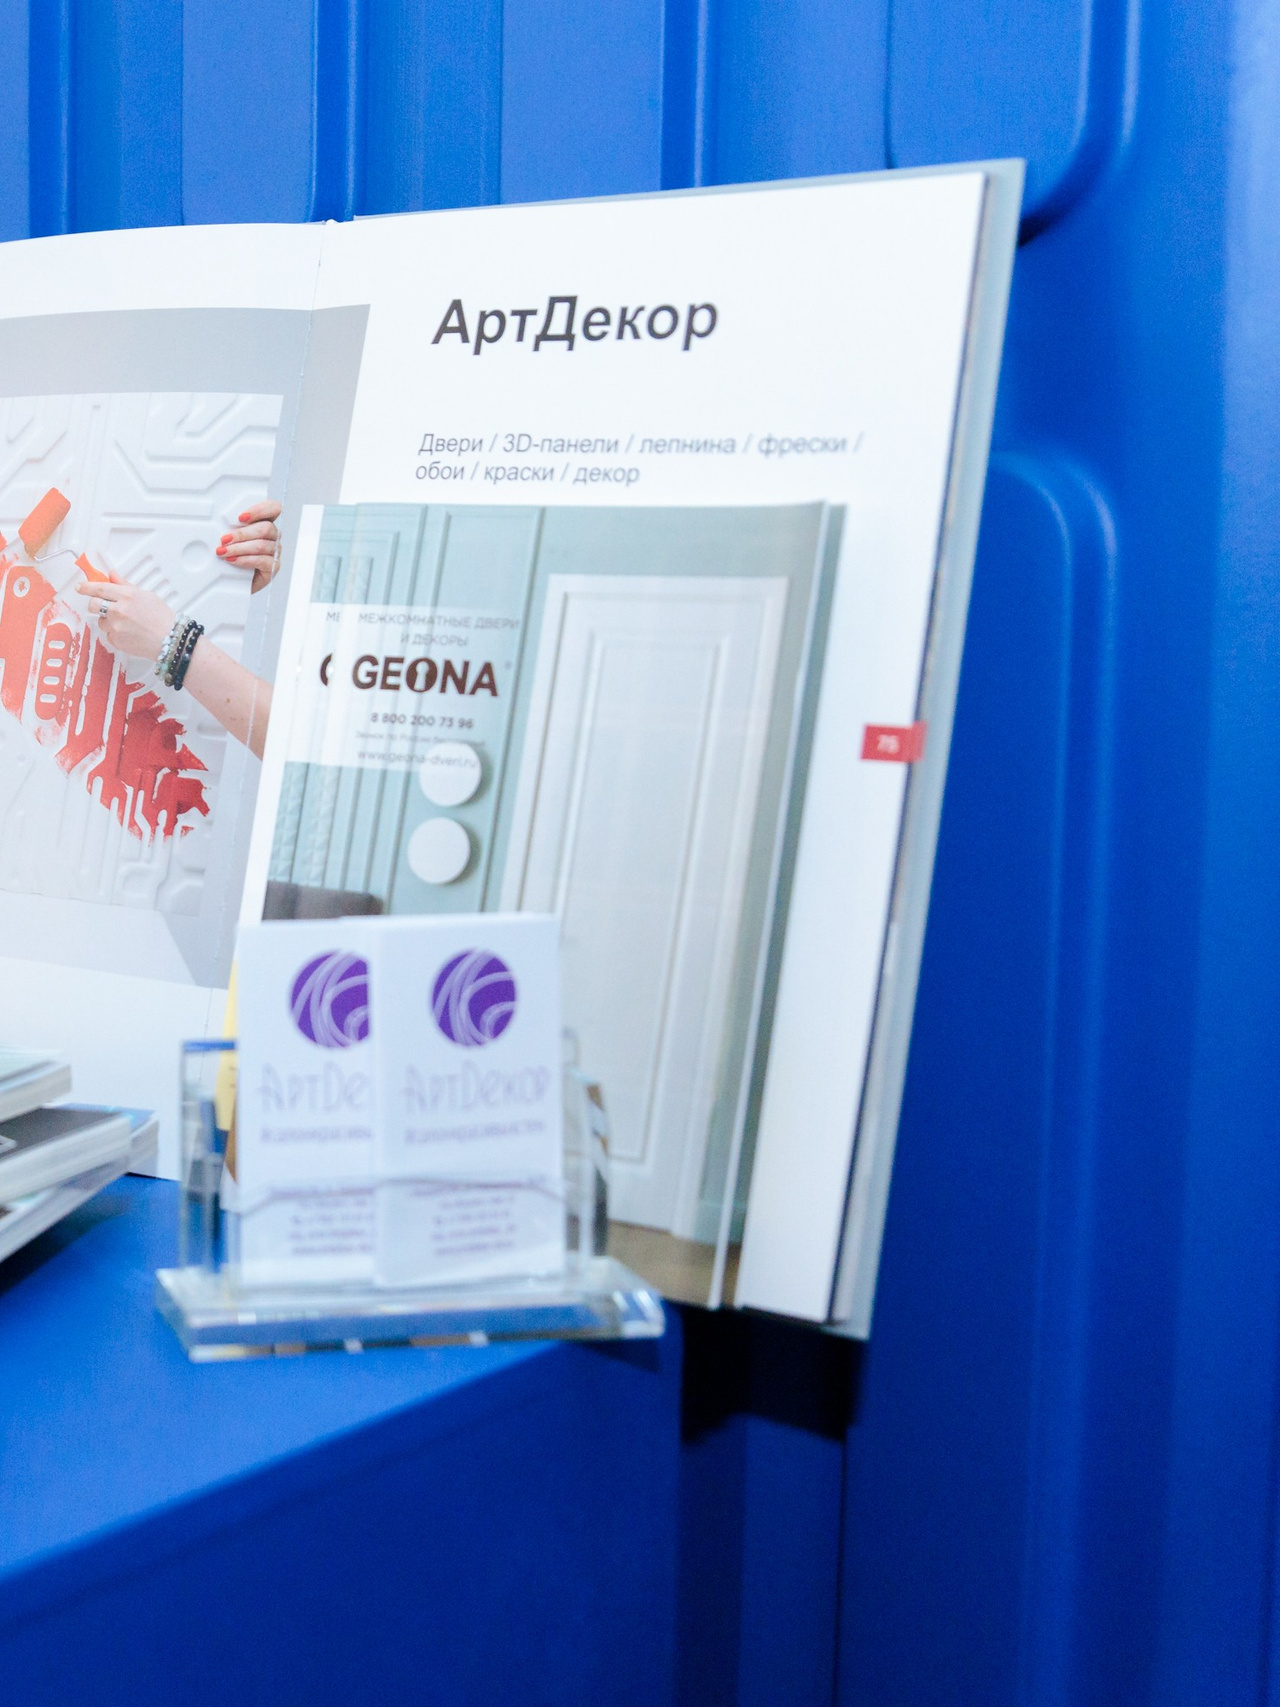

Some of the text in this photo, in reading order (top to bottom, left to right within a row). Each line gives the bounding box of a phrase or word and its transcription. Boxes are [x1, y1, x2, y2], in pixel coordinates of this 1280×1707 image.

[431, 295, 718, 356] АртДекор
[417, 433, 483, 456] Двери
[502, 433, 619, 454] 3D-панели
[639, 435, 737, 456] лепнина
[757, 432, 848, 459] фрески
[415, 460, 465, 481] обои
[483, 465, 554, 486] краски
[573, 465, 640, 488] декор
[352, 654, 498, 698] GEONA
[381, 713, 407, 724] 800
[410, 714, 436, 727] 200
